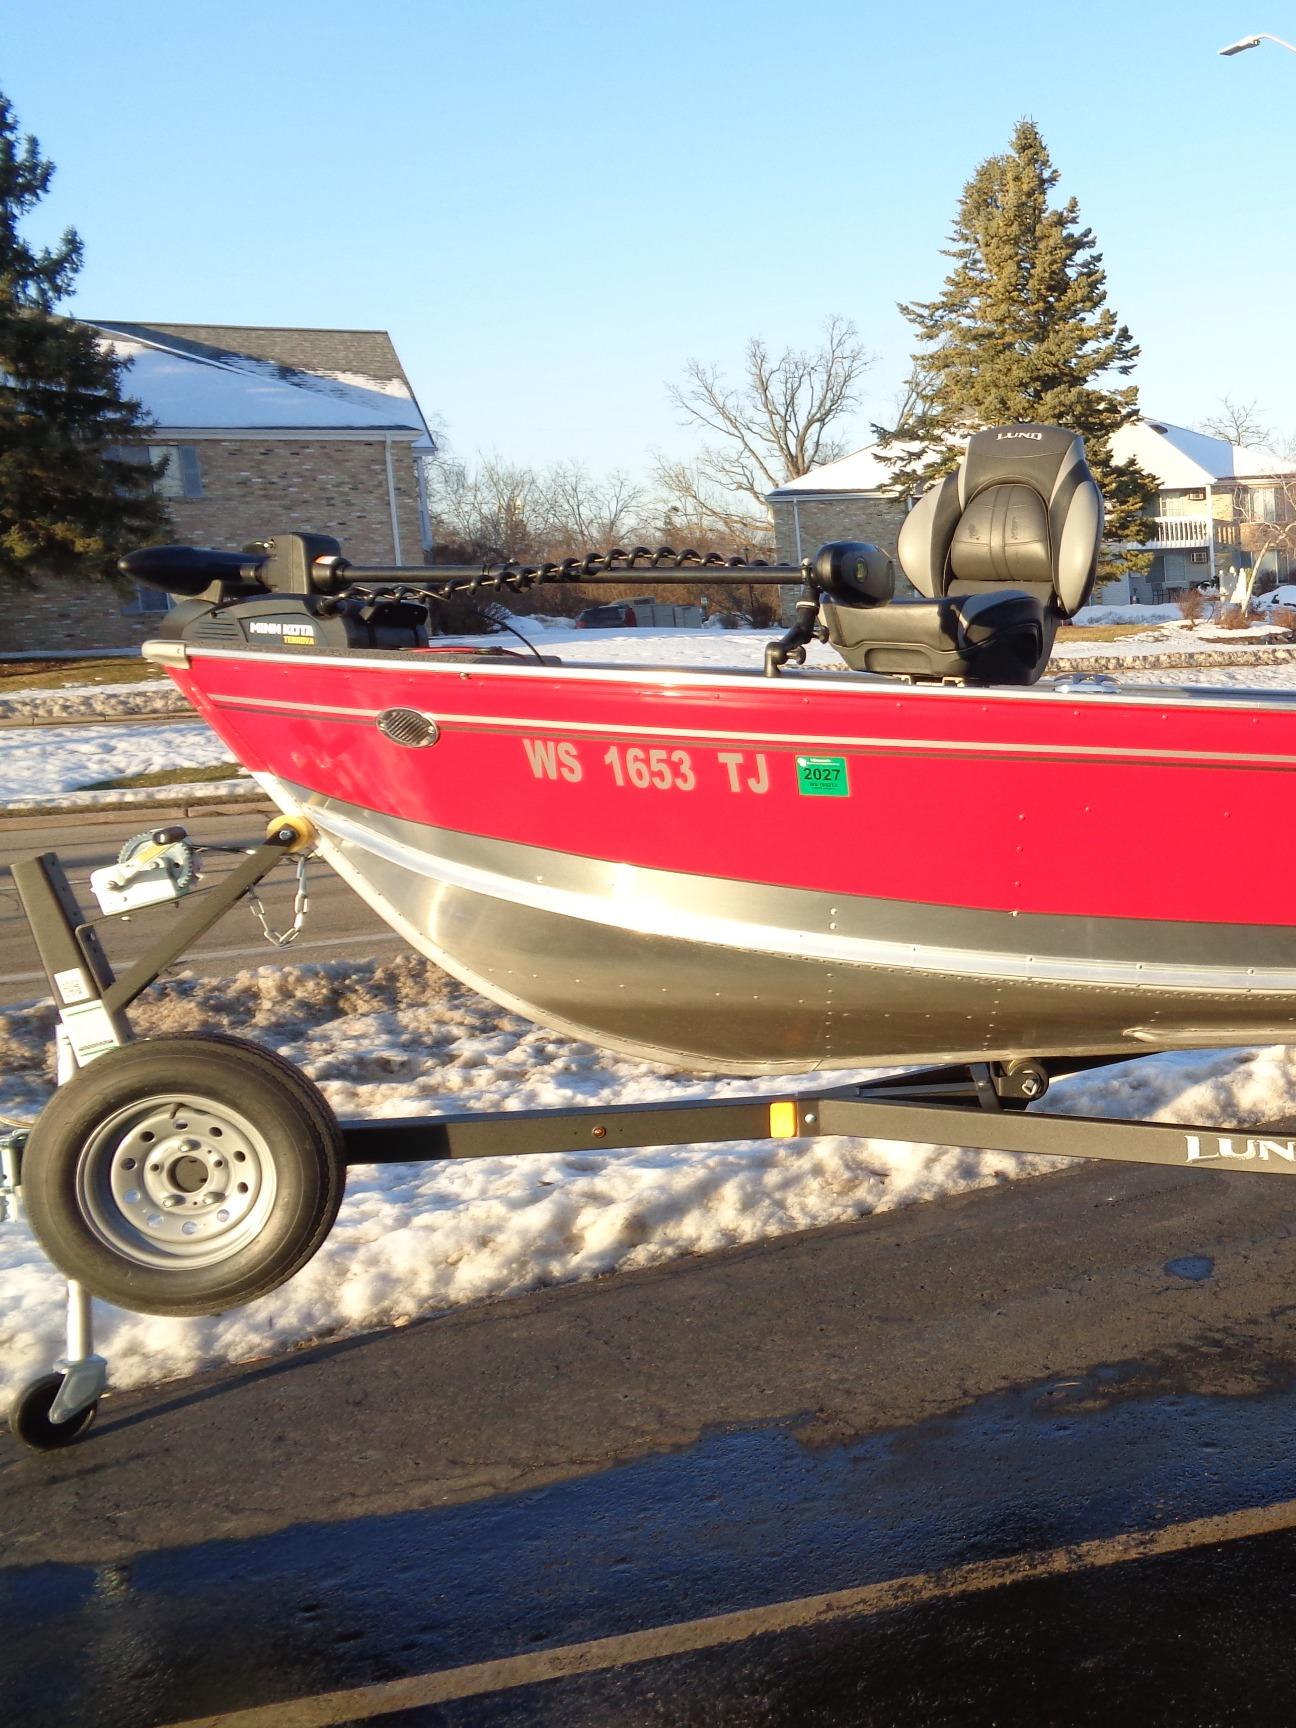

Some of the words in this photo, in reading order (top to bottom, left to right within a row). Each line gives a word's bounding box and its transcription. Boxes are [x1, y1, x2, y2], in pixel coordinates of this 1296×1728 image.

[996, 432, 1042, 441] LUND
[249, 622, 281, 634] MINN
[282, 624, 314, 636] KOTA
[522, 738, 583, 783] WS
[604, 745, 696, 791] 1653
[717, 752, 769, 794] TJ
[802, 767, 841, 781] 2027
